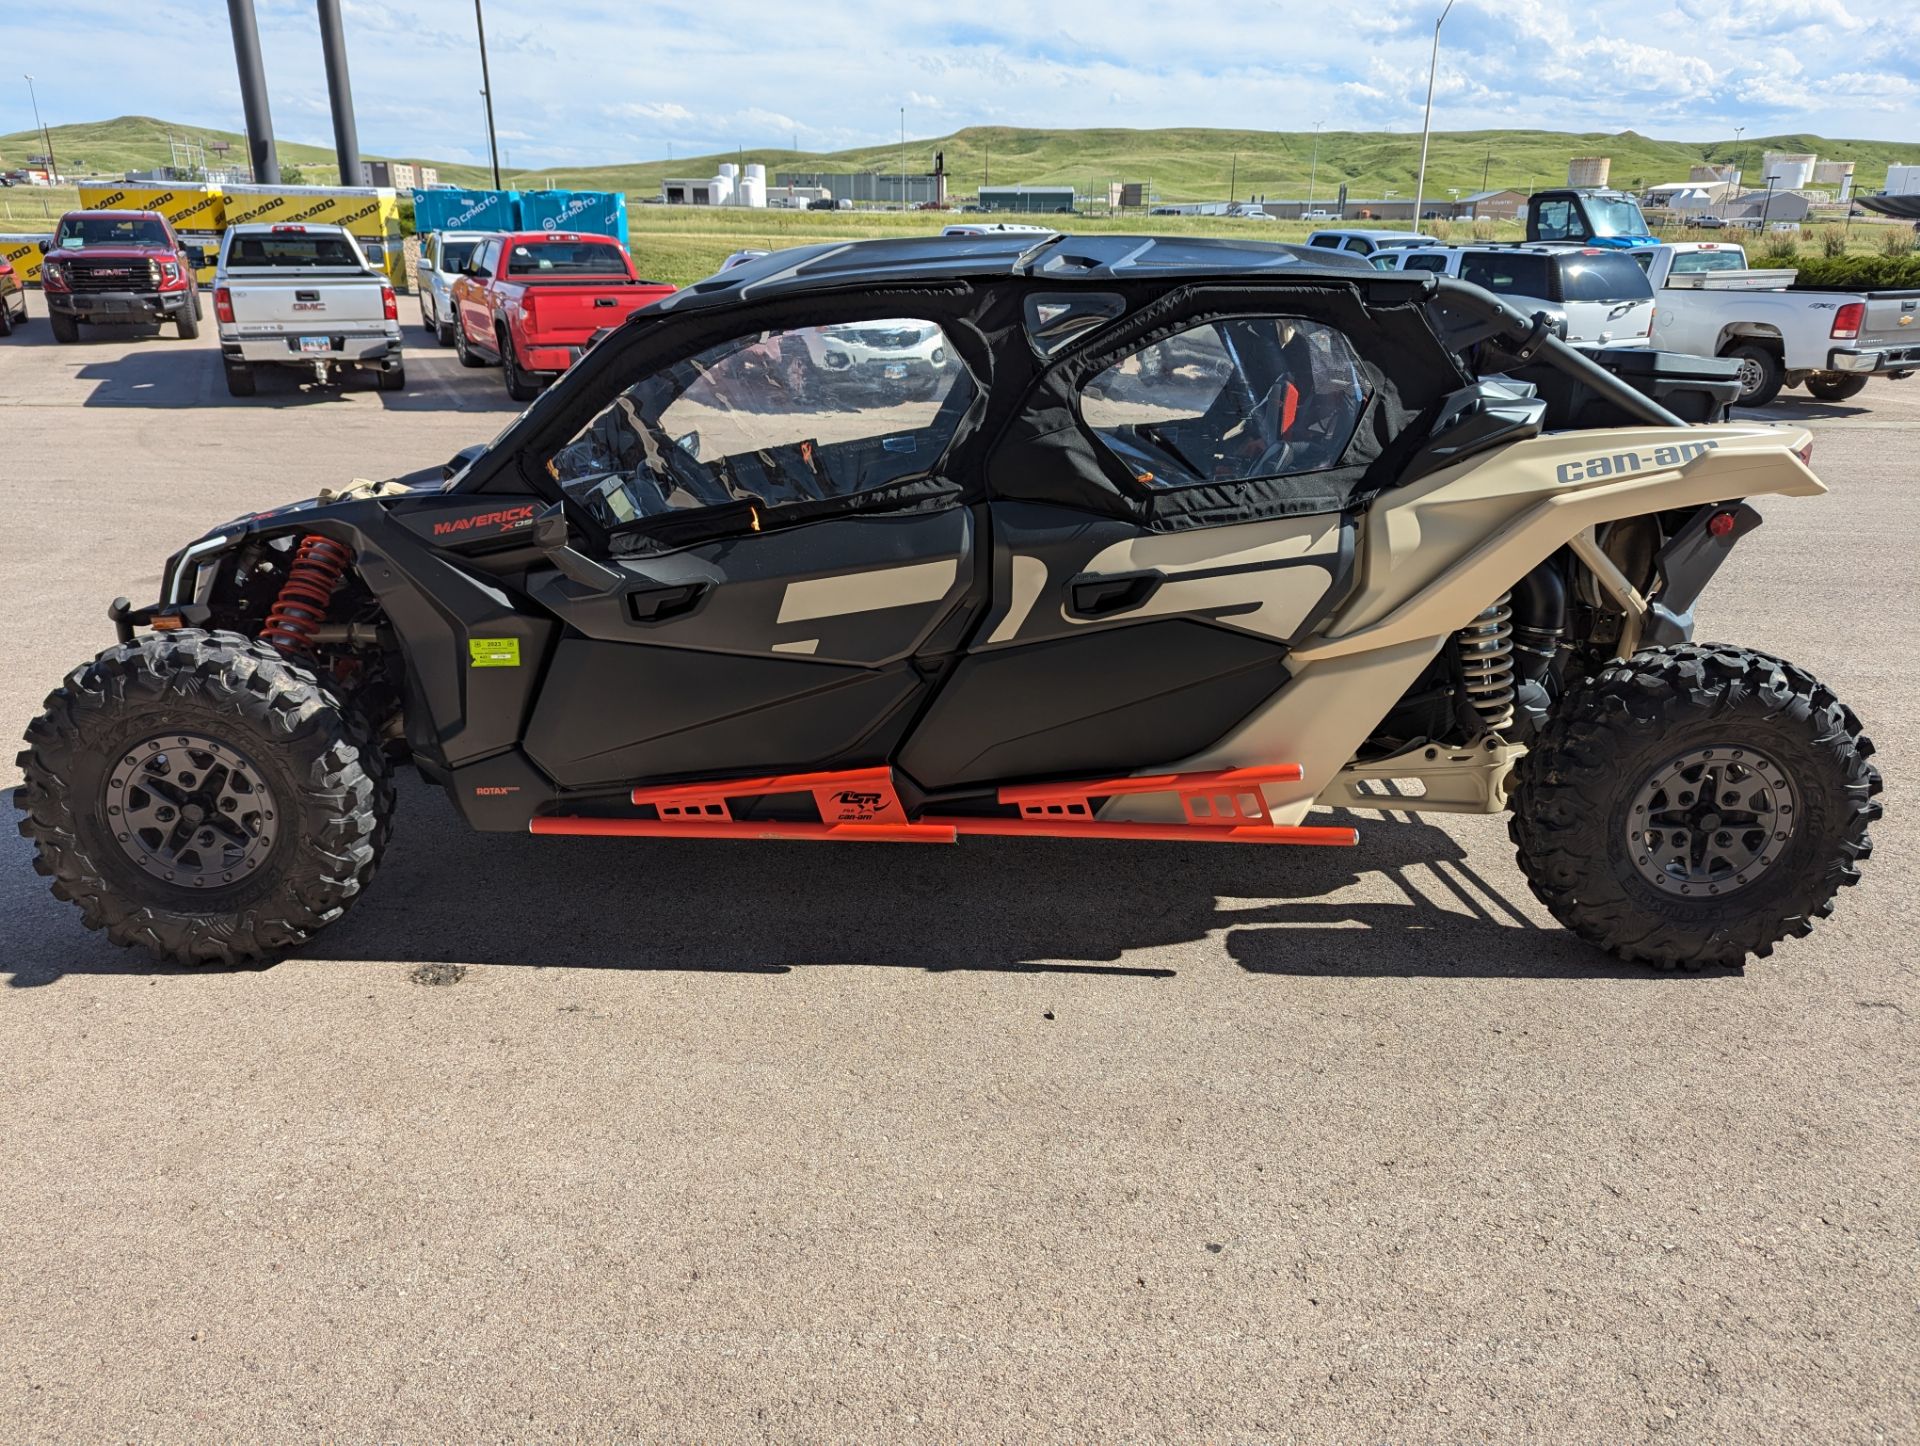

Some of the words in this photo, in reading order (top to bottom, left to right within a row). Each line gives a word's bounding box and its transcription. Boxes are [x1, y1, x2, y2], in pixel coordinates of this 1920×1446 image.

[460, 195, 498, 223] CFMOTO
[556, 197, 596, 224] CFMOTO
[93, 268, 129, 276] GMC
[293, 303, 326, 311] GMC
[1556, 440, 1719, 484] can-am
[433, 505, 534, 535] MAVERICK
[476, 787, 508, 795] ROTAX
